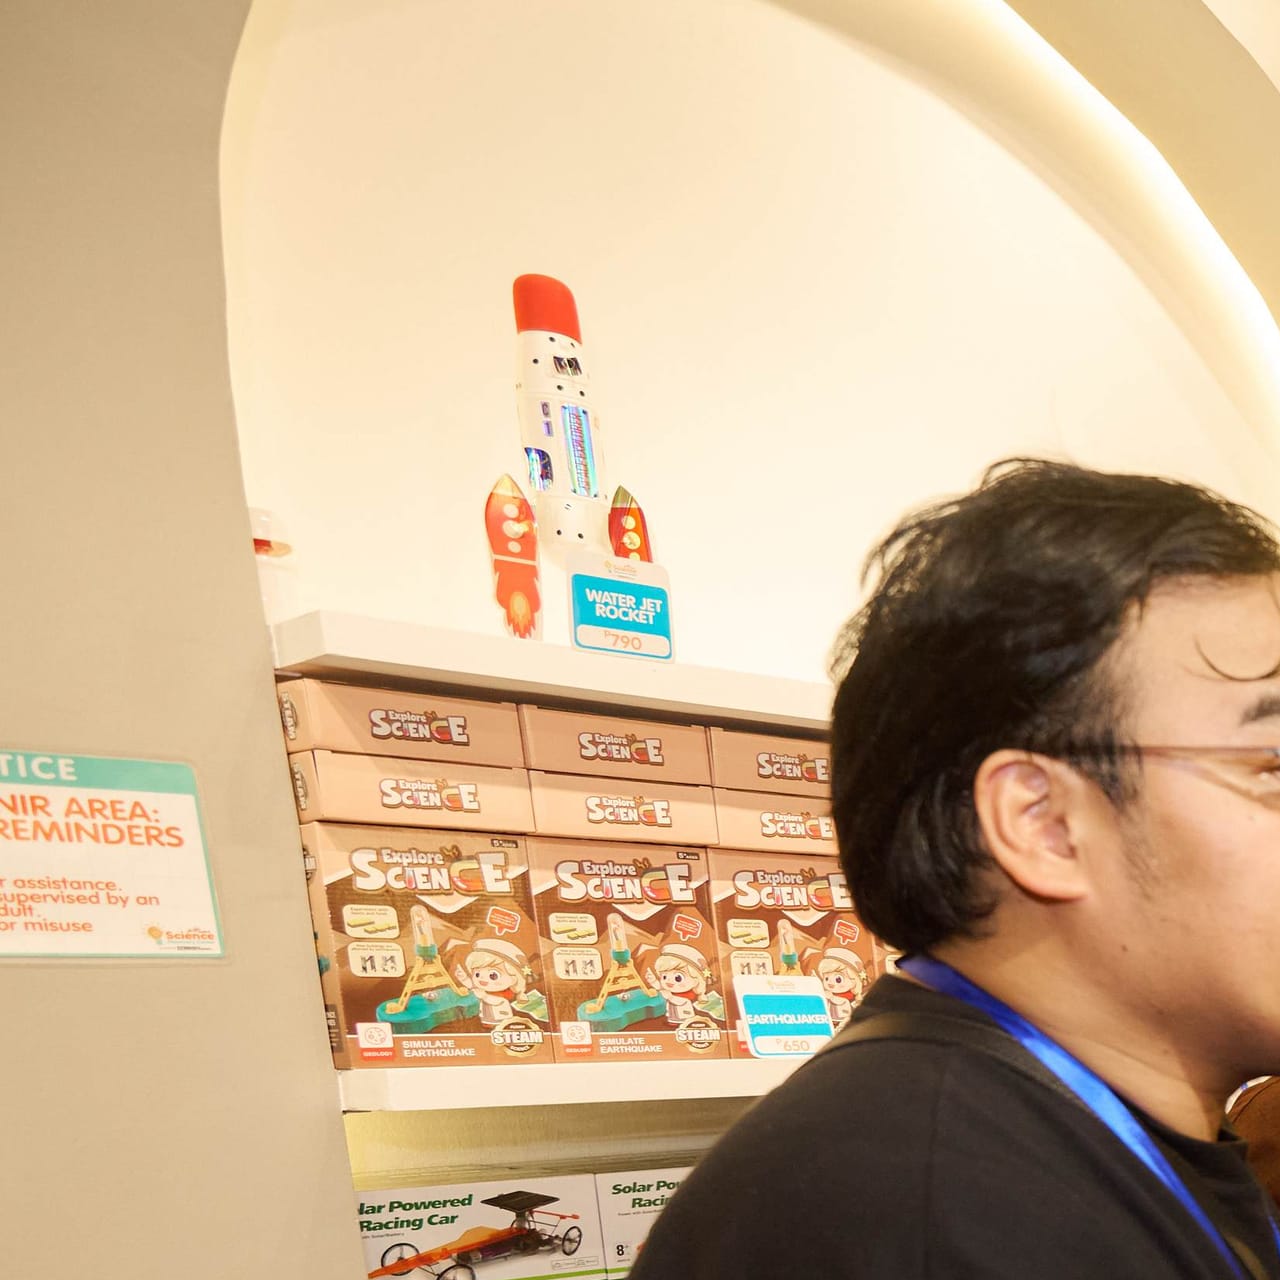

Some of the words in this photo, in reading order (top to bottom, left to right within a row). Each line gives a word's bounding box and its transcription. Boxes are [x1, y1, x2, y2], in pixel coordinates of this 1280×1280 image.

[585, 588, 636, 608] WATER
[640, 598, 663, 612] JET
[596, 603, 656, 625] ROCKET
[388, 710, 426, 723] Explore
[595, 734, 627, 745] Explore
[0, 753, 78, 782] TICE
[399, 779, 437, 791] Explore
[602, 797, 635, 807] Explore
[64, 797, 161, 823] AREA:
[381, 848, 444, 866] Explore
[351, 848, 511, 893] SCIENCE
[582, 861, 636, 876] Explore
[14, 876, 123, 892] assistance.
[557, 860, 694, 901] SCIENCE
[756, 871, 803, 885] Explore
[107, 892, 129, 909] by
[136, 895, 160, 906] an
[24, 920, 93, 932] misuse
[747, 1014, 828, 1025] EARTHQUAKER
[493, 1031, 543, 1044] STEAM
[599, 1037, 645, 1045] SIMULATE
[677, 1029, 720, 1041] STEAM
[402, 1040, 455, 1049] SIMULATE
[600, 1045, 662, 1054] EARTHQUAKE
[403, 1048, 475, 1057] EARTHQUAKE
[612, 1181, 654, 1195] Solar
[359, 1202, 385, 1215] lar
[389, 1194, 473, 1213] Powered
[428, 1213, 459, 1226] Car
